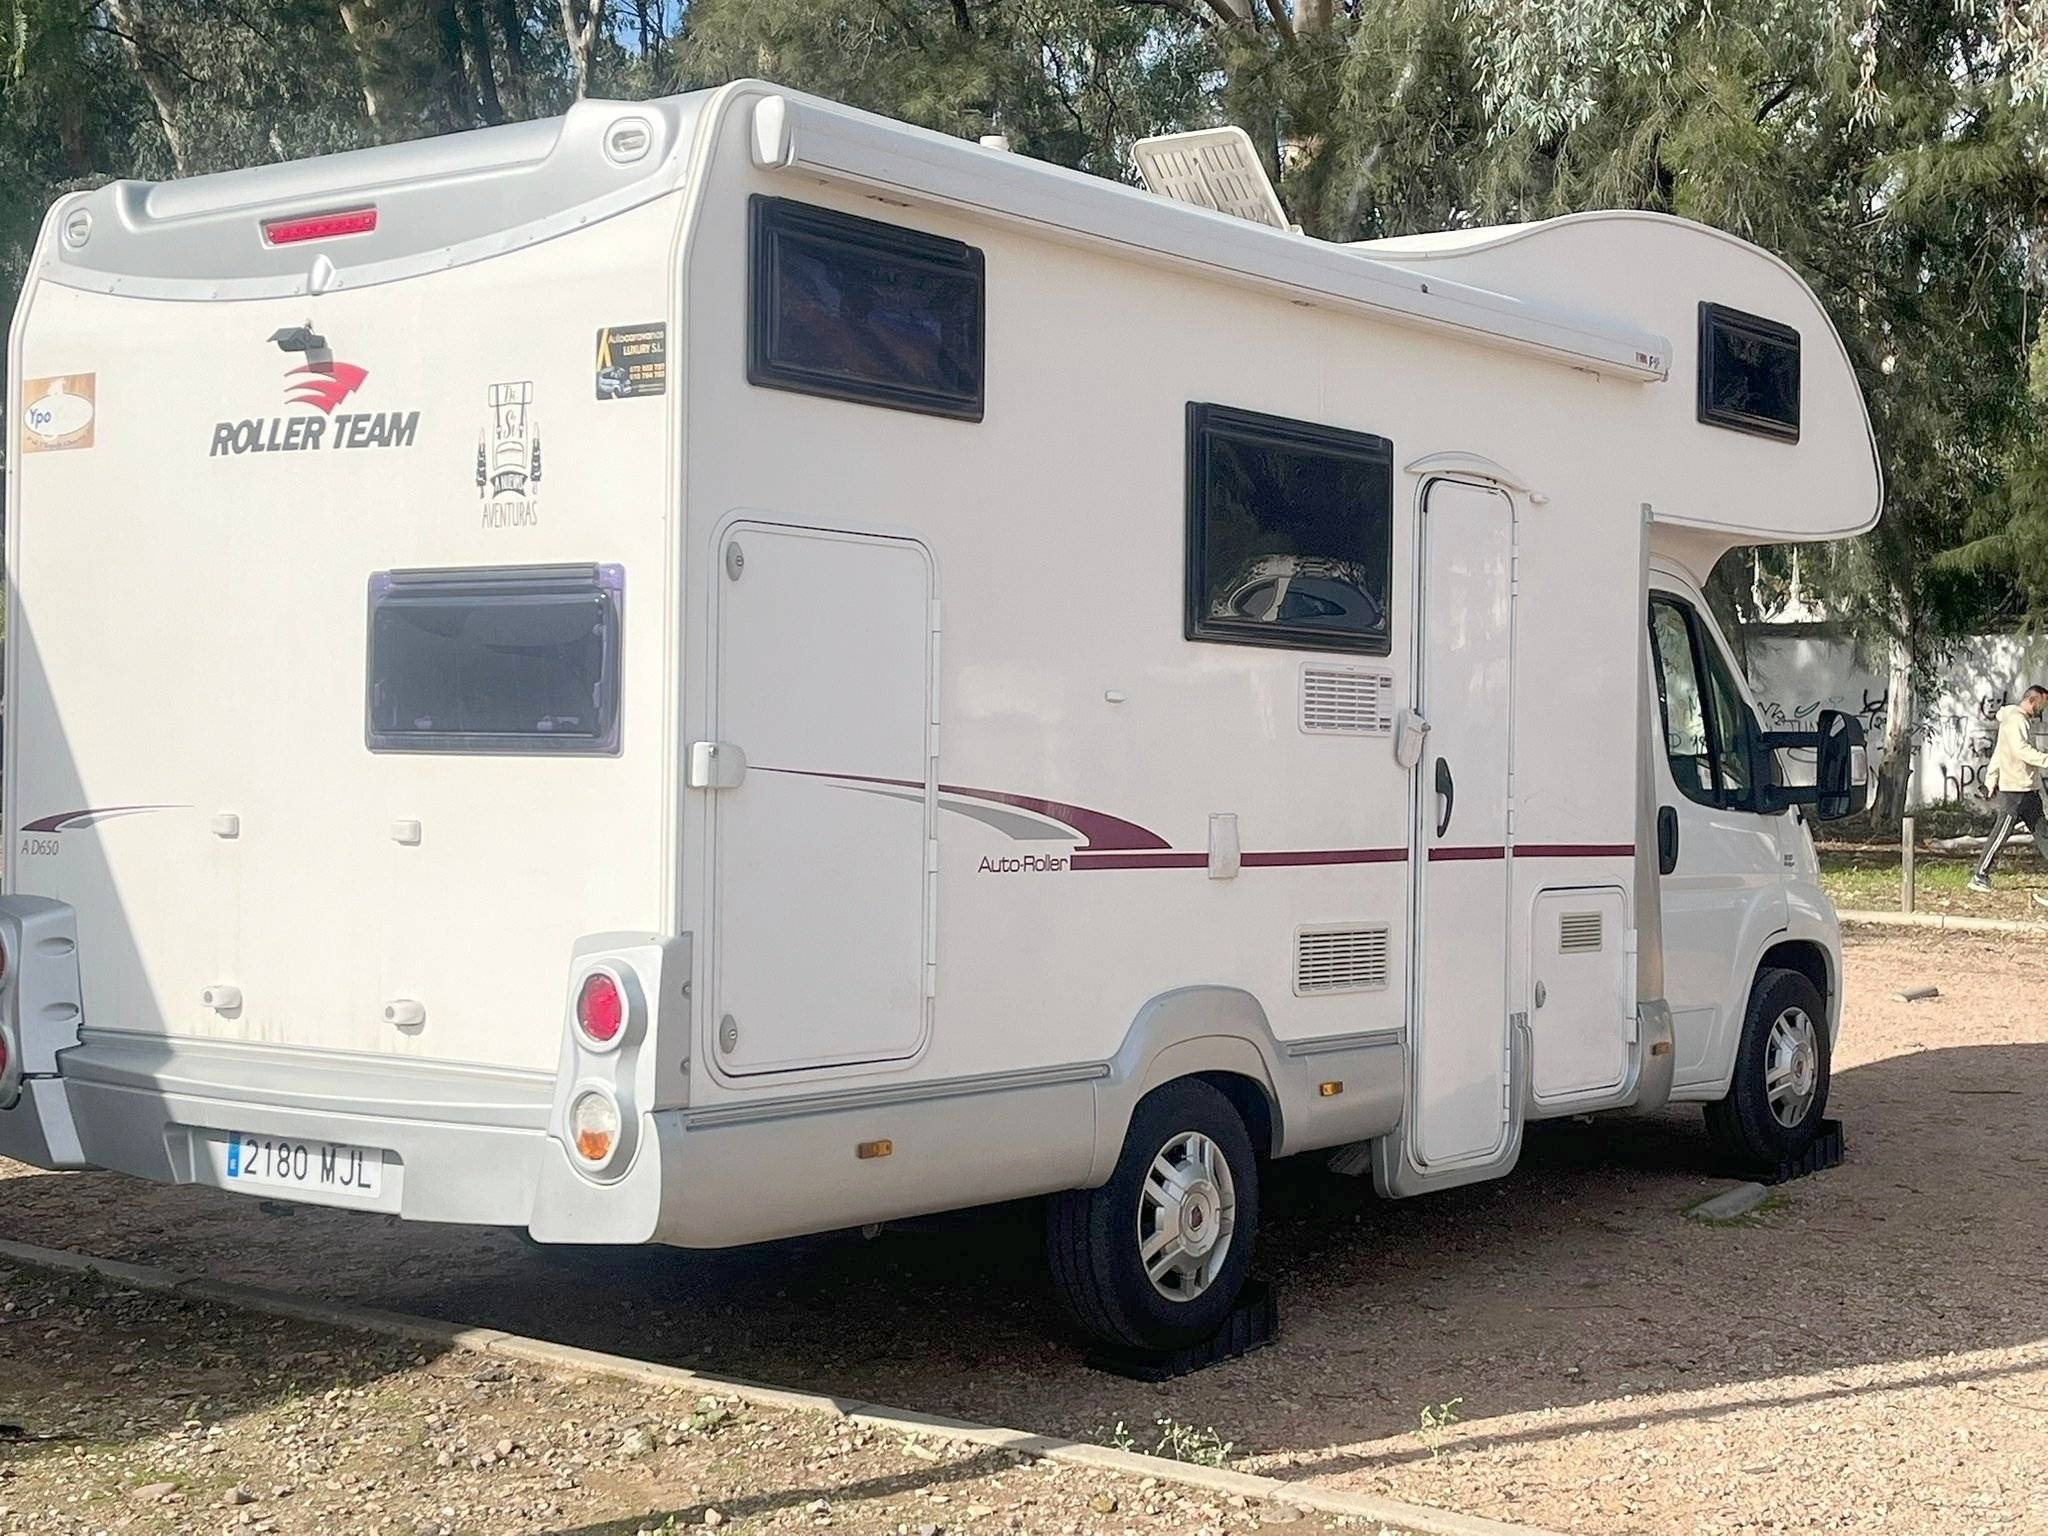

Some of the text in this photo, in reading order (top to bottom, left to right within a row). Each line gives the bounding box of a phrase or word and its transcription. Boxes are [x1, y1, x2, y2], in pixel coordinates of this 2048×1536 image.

[209, 411, 420, 457] ROLLER TEAM
[481, 501, 538, 528] AVENTURAS
[978, 853, 1069, 873] Auto-Roller
[244, 1139, 372, 1189] 2180 MJL
